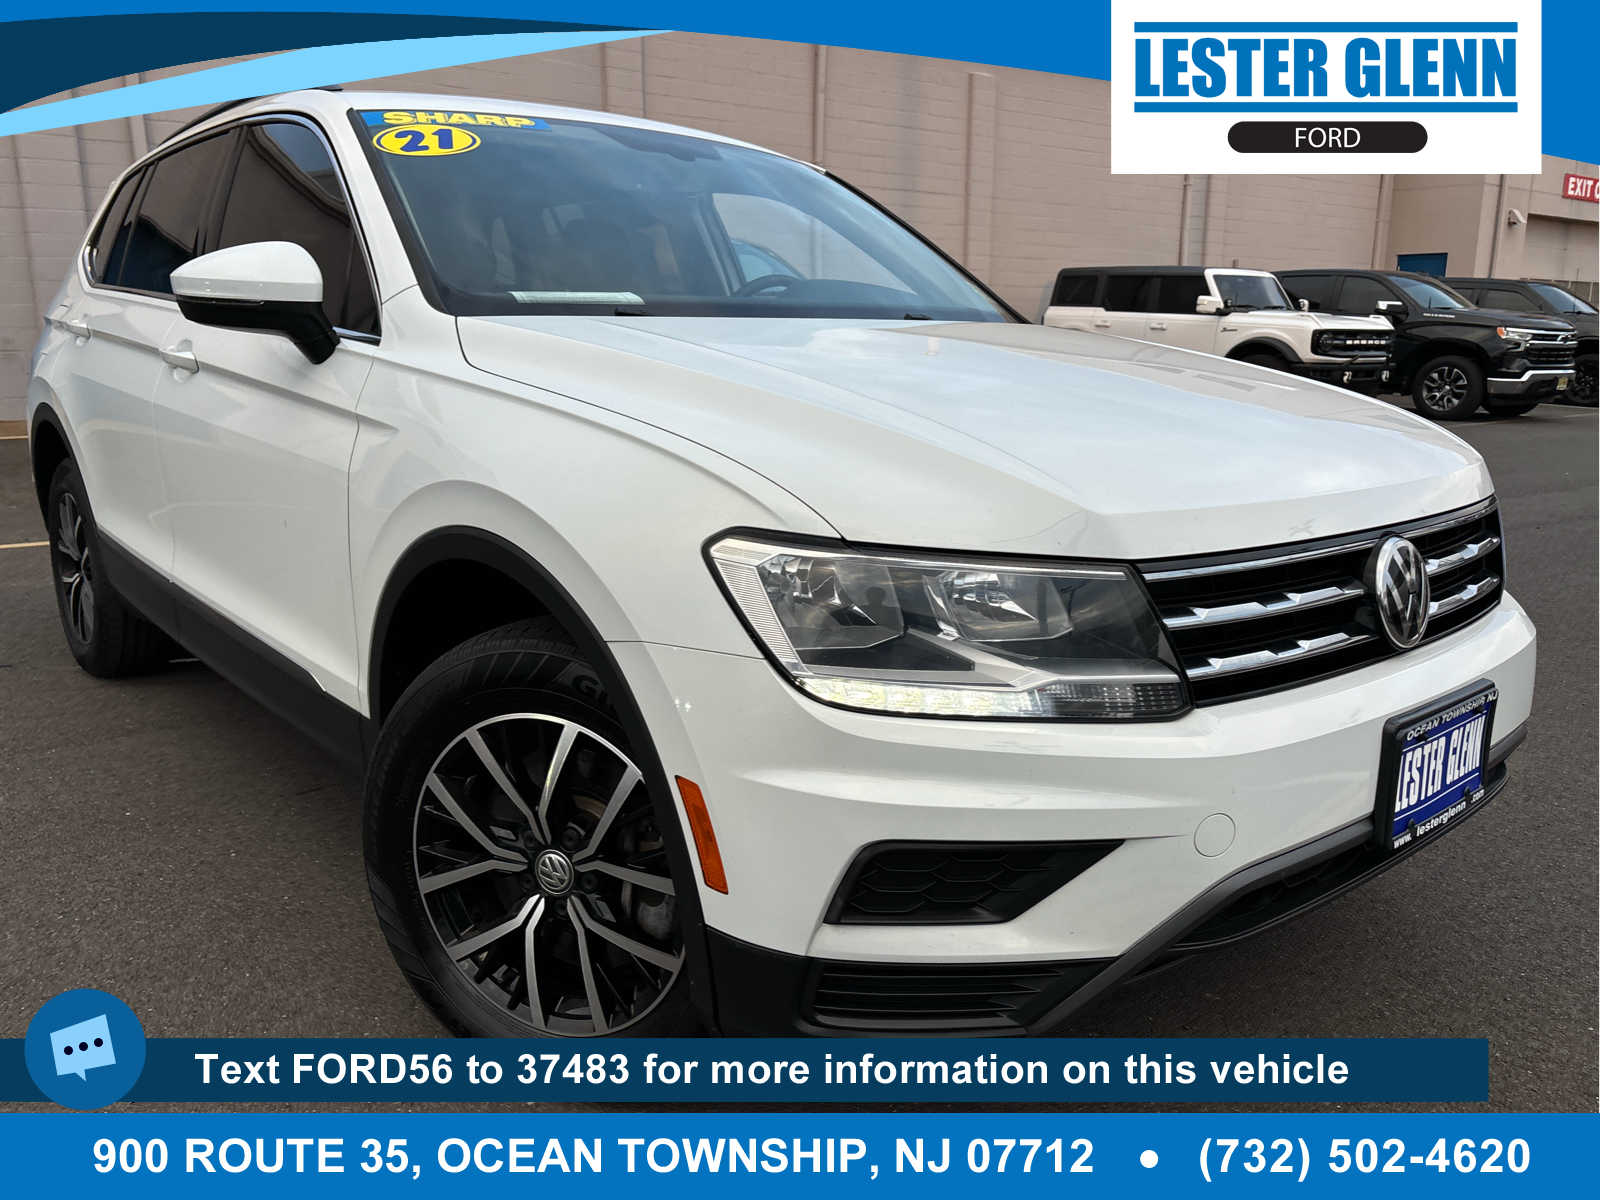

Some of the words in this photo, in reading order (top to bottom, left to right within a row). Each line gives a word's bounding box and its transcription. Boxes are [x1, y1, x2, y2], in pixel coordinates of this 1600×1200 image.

[383, 111, 535, 128] SHARP
[394, 128, 454, 152] 21
[1567, 176, 1594, 198] EXIT
[1406, 718, 1440, 741] OCEAN
[1486, 689, 1498, 702] NJ
[1394, 736, 1447, 813] LESTER
[1446, 714, 1486, 785] GLENN
